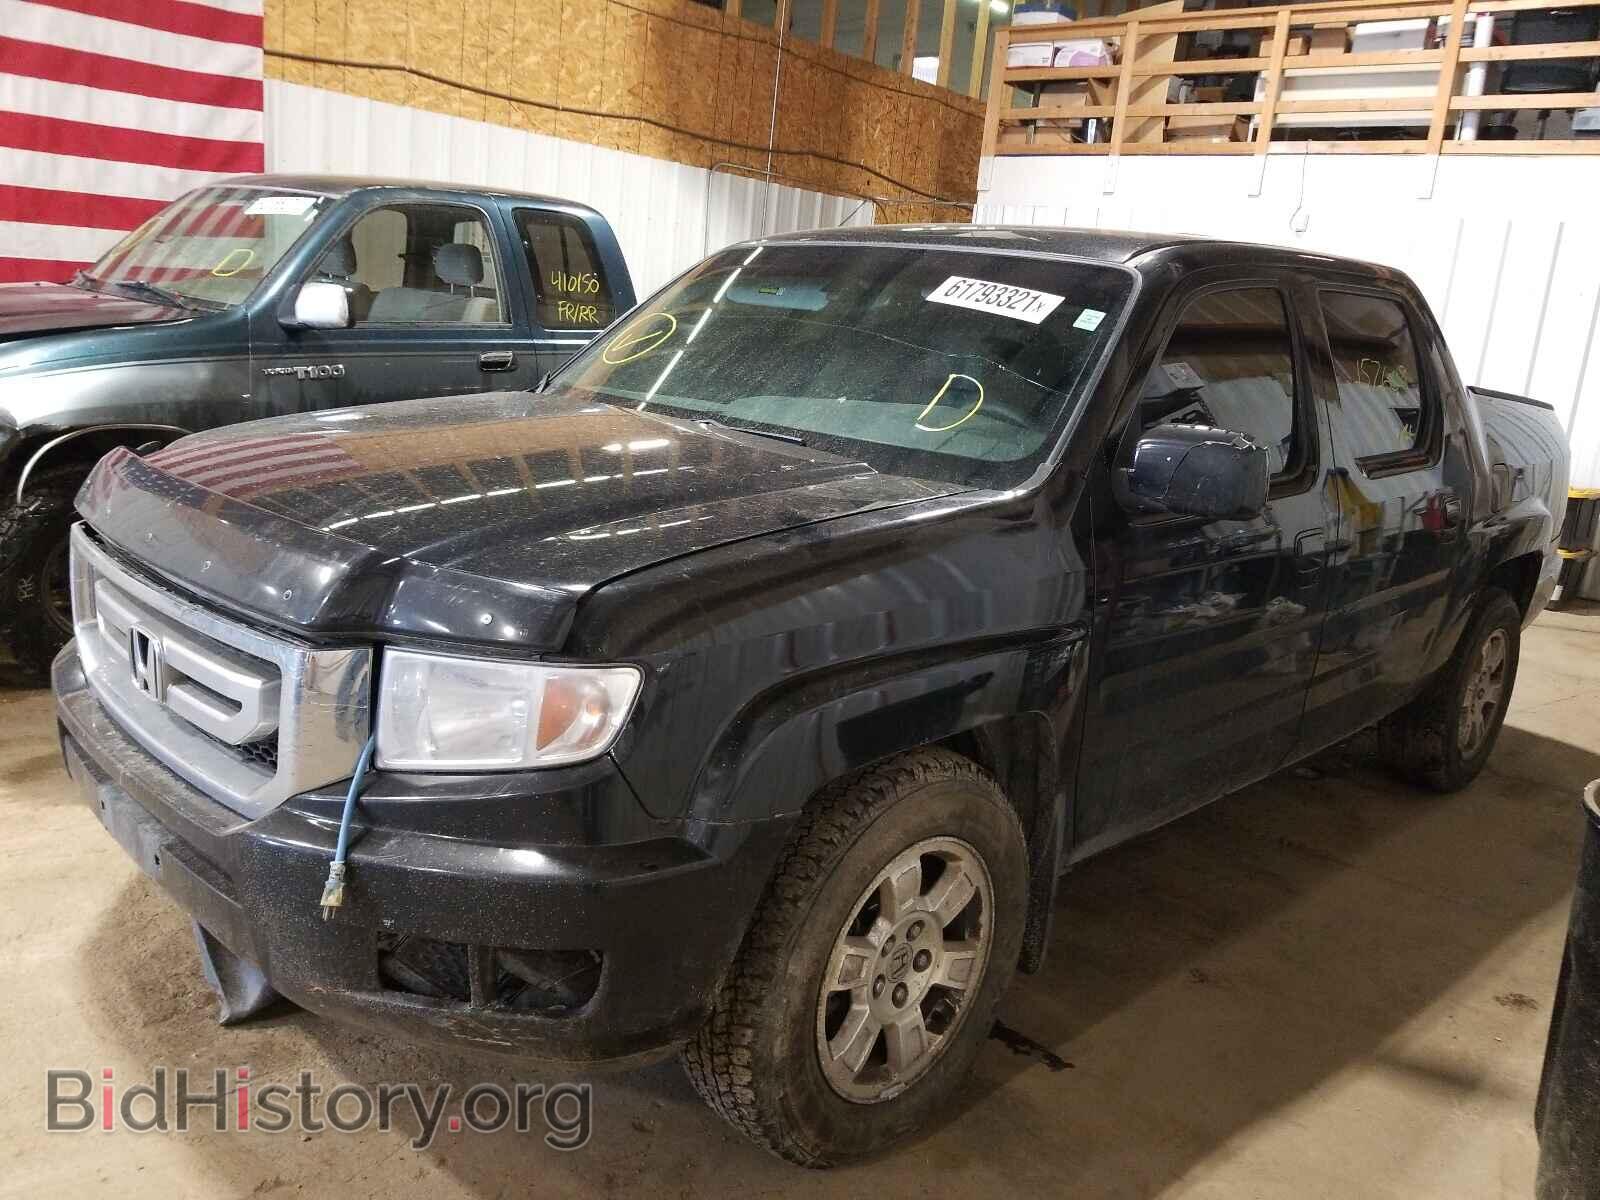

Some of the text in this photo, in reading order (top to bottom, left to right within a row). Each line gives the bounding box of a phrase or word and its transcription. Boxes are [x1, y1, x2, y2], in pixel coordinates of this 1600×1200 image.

[558, 300, 600, 325] FR/RR
[293, 364, 346, 380] T100
[914, 373, 984, 432] D
